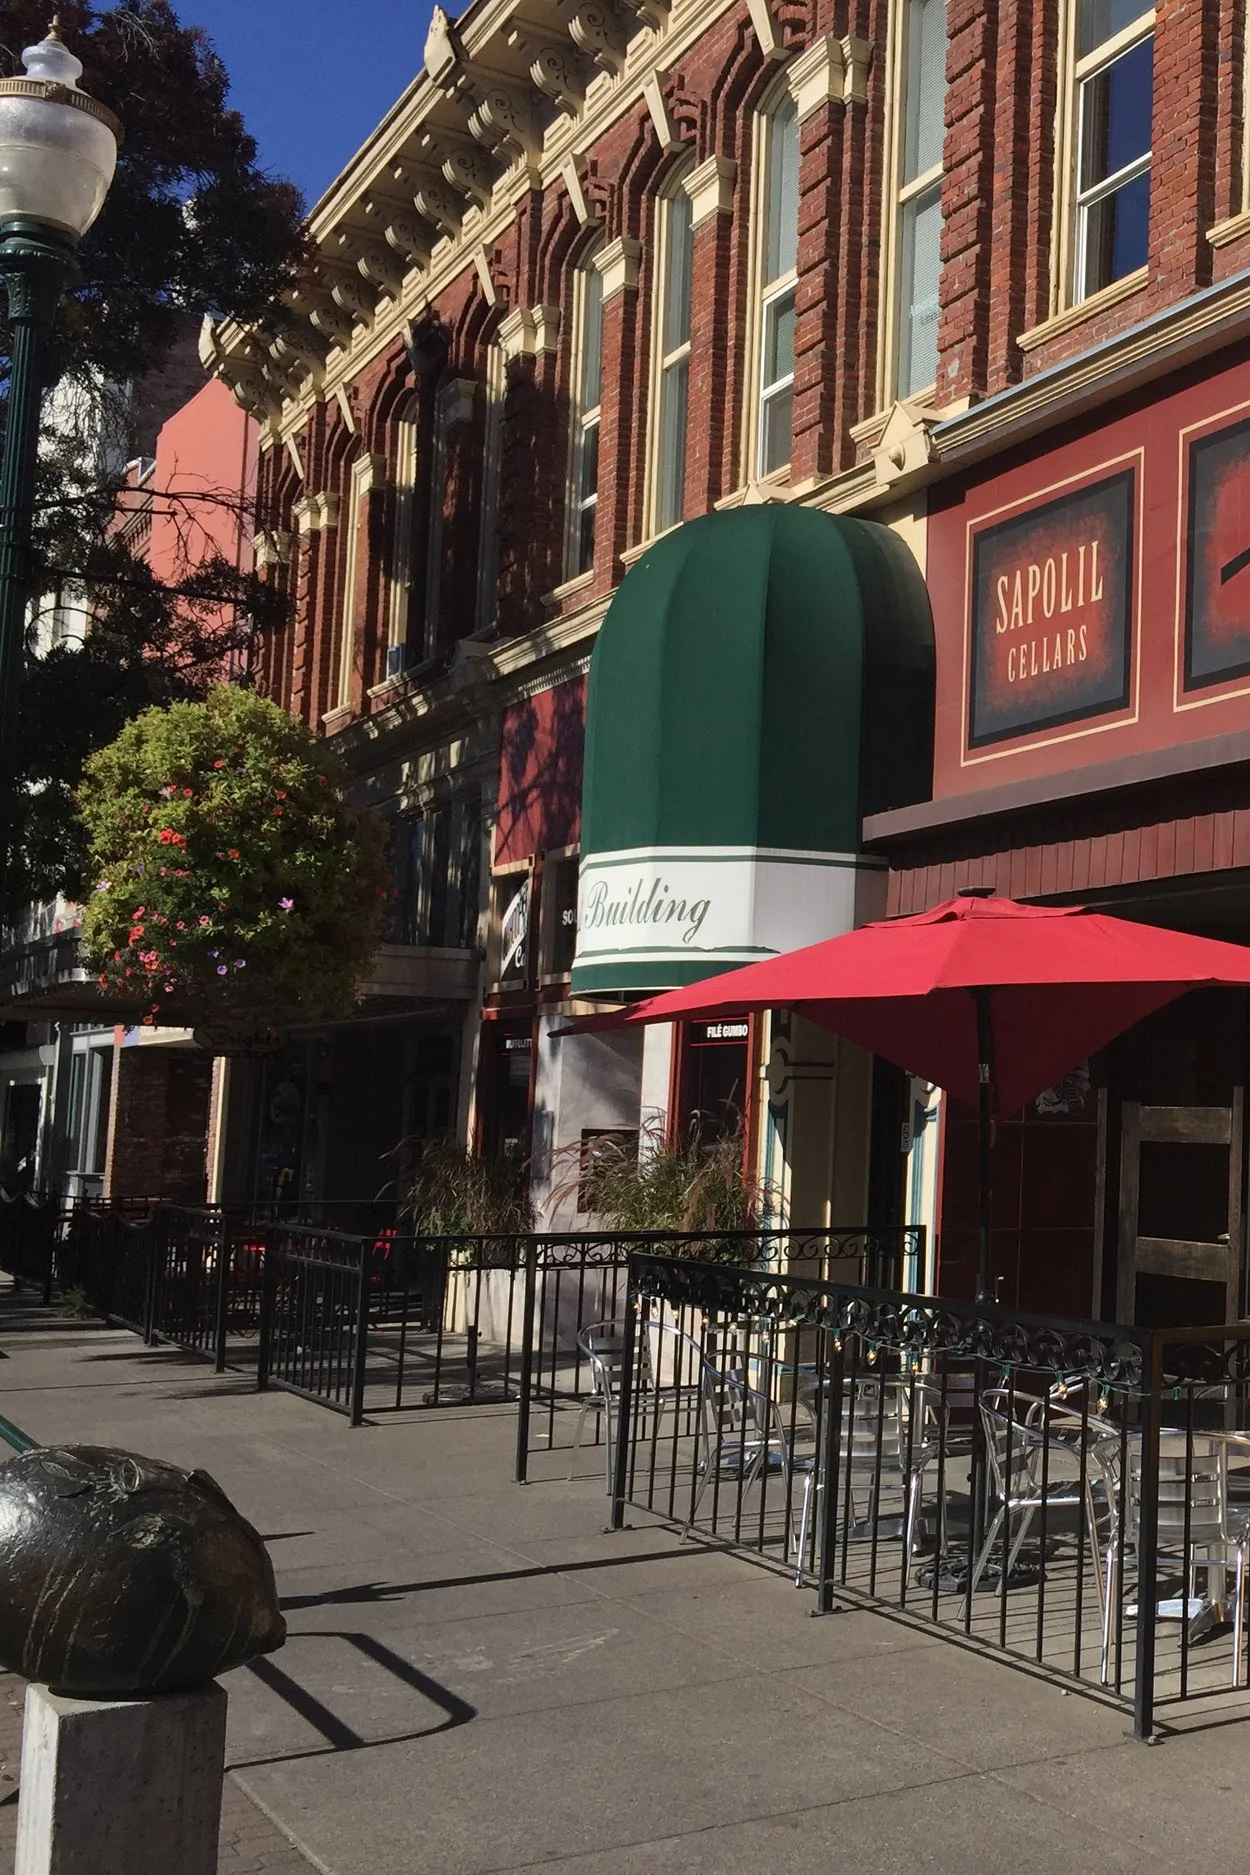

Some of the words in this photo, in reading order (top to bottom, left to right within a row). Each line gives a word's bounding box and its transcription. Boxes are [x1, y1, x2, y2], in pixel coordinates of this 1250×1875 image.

[996, 540, 1103, 634] SAPOLIL
[1008, 625, 1087, 682] CELLARS
[585, 877, 711, 944] Building
[707, 1023, 722, 1038] FILÉ
[722, 1024, 748, 1037] GUMBO
